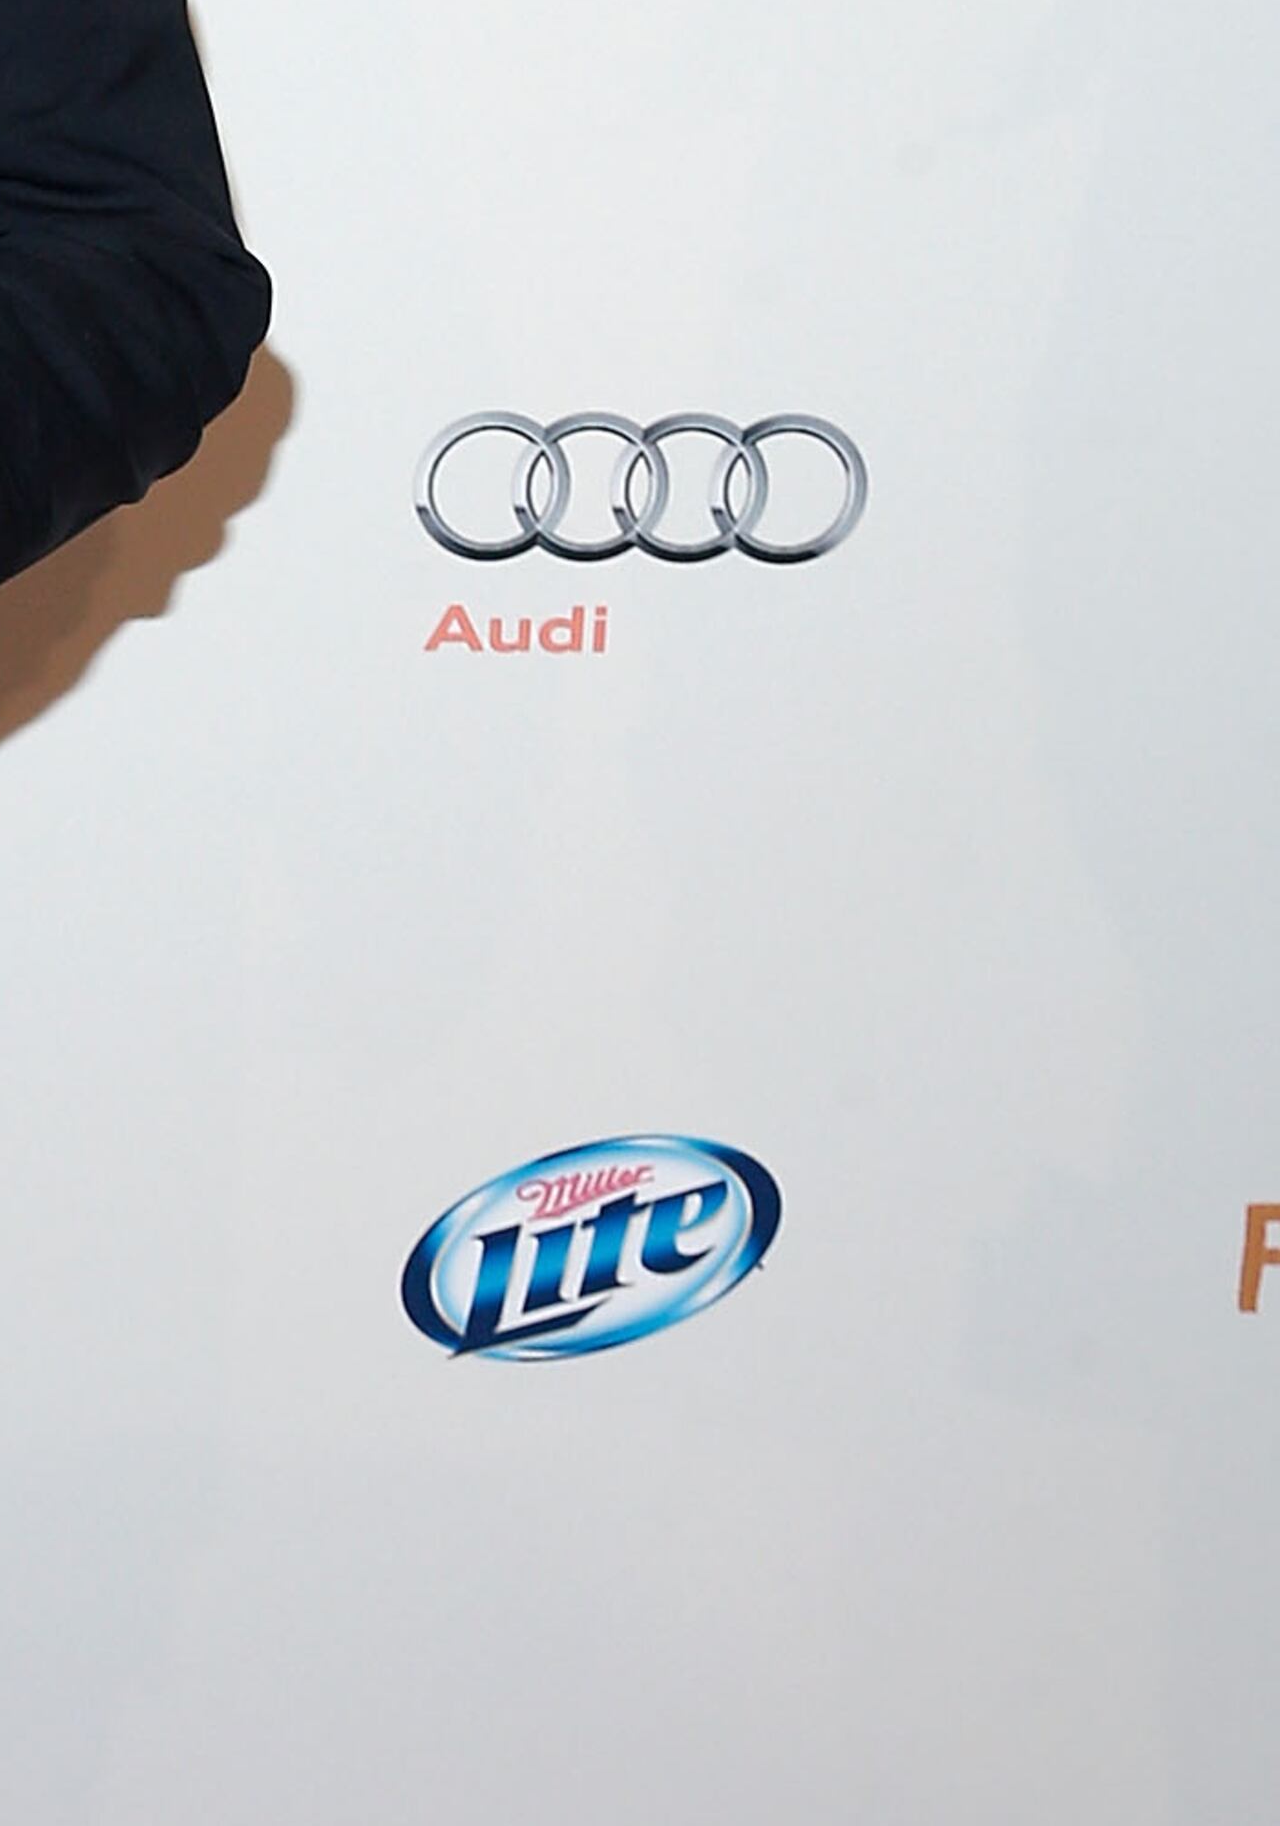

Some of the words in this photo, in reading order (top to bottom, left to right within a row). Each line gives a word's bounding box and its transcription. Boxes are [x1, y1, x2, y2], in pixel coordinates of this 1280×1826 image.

[424, 604, 608, 653] Audi
[516, 1164, 656, 1221] Miller
[448, 1180, 729, 1360] Lite
